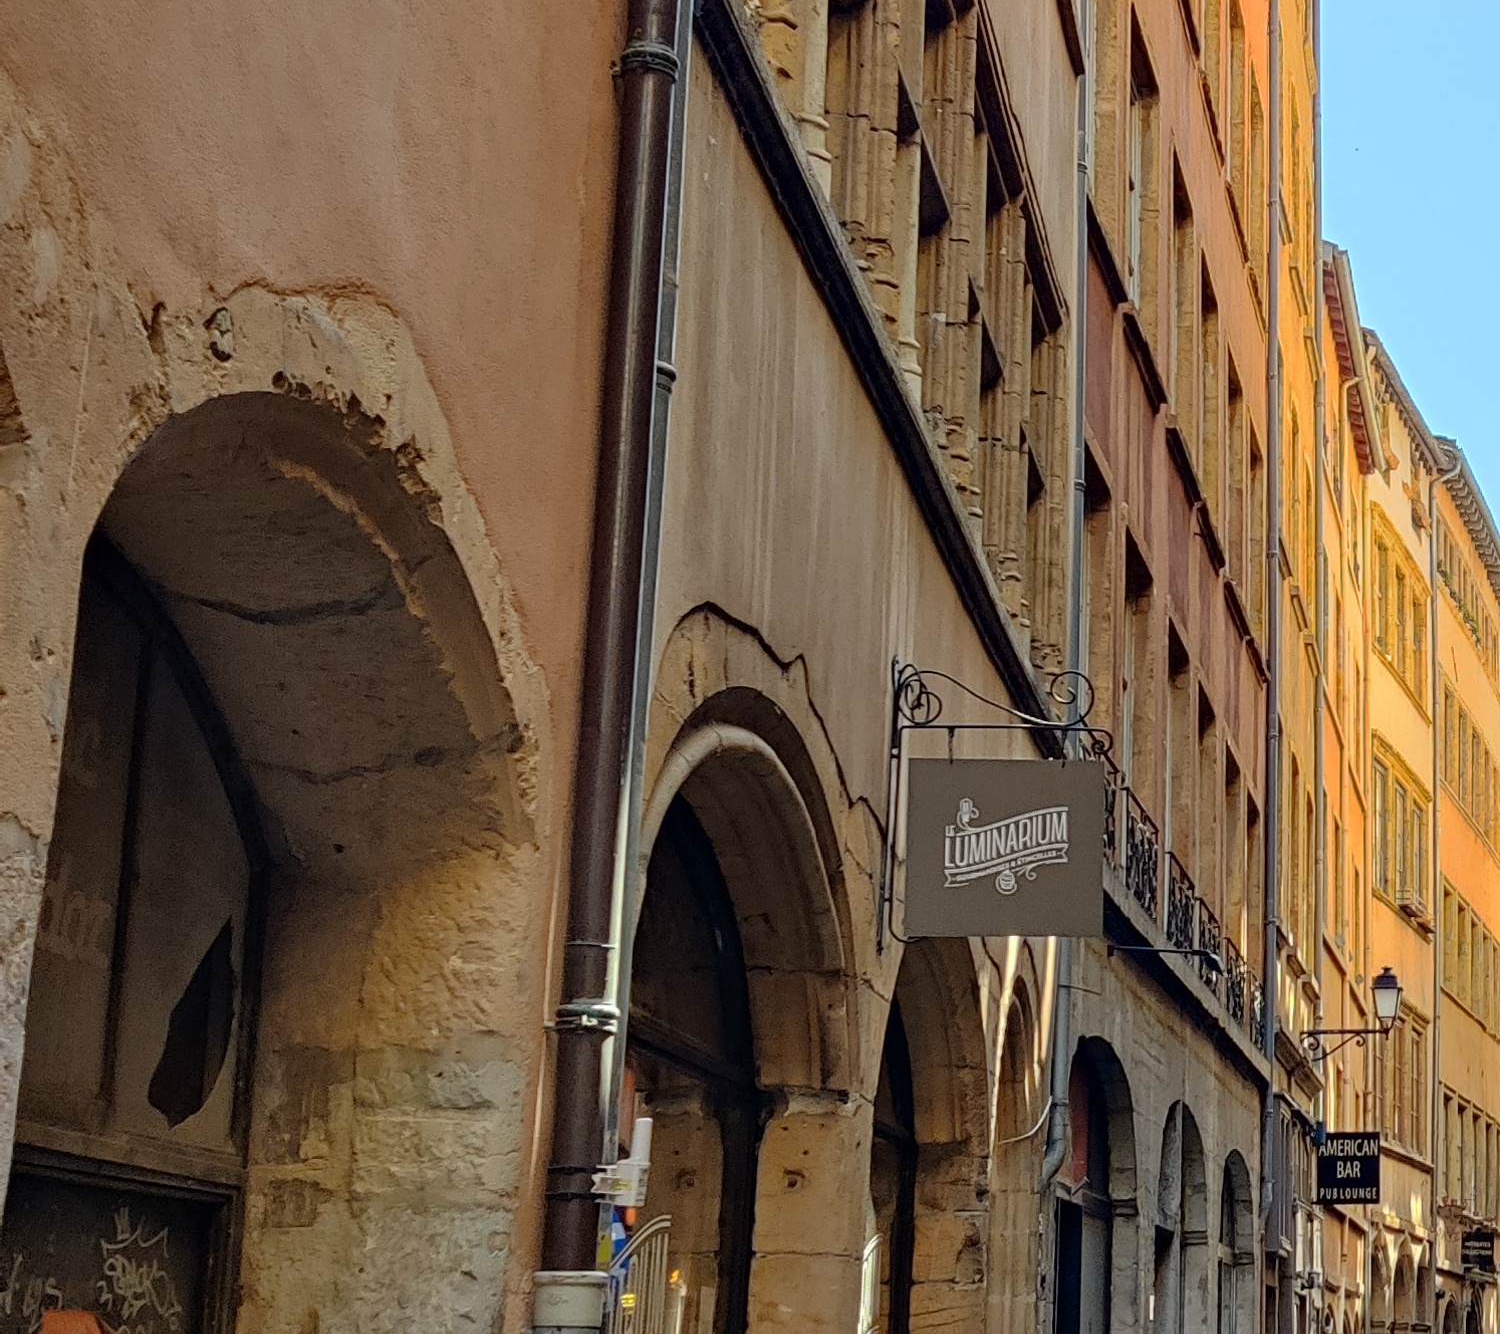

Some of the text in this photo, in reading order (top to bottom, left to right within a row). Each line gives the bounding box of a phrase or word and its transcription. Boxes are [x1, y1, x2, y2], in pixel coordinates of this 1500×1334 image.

[944, 811, 1069, 868] LUMINARIUM
[1318, 1138, 1379, 1157] AMERICAN
[1336, 1160, 1361, 1178] BAR
[1319, 1187, 1377, 1199] PUB LOUNGE
